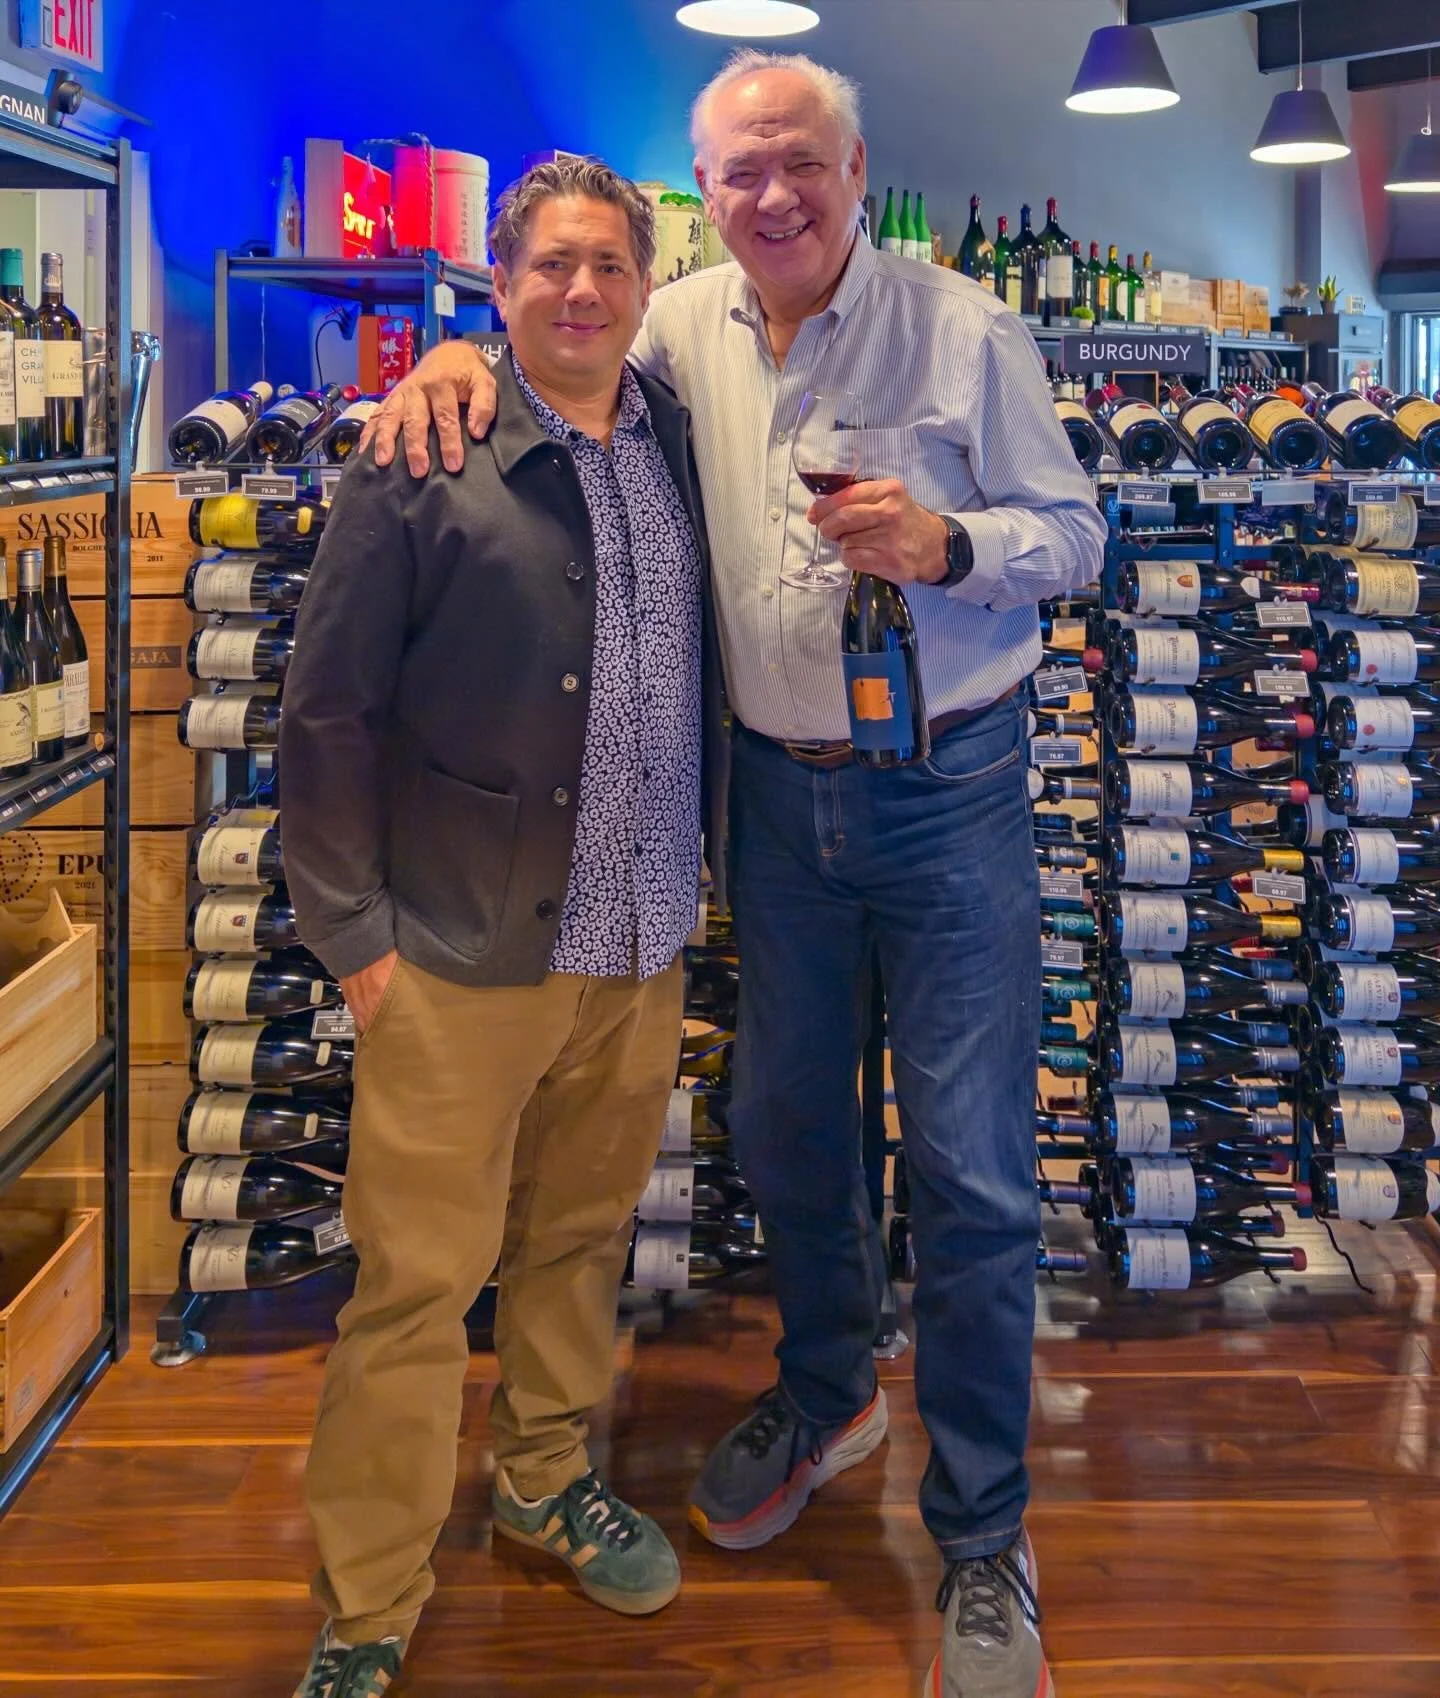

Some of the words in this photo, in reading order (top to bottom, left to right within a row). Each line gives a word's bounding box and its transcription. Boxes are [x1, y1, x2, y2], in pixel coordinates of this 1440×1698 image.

[55, 0, 92, 60] EXIT
[1079, 343, 1192, 361] BURGUNDY
[18, 511, 165, 541] SASSIIA
